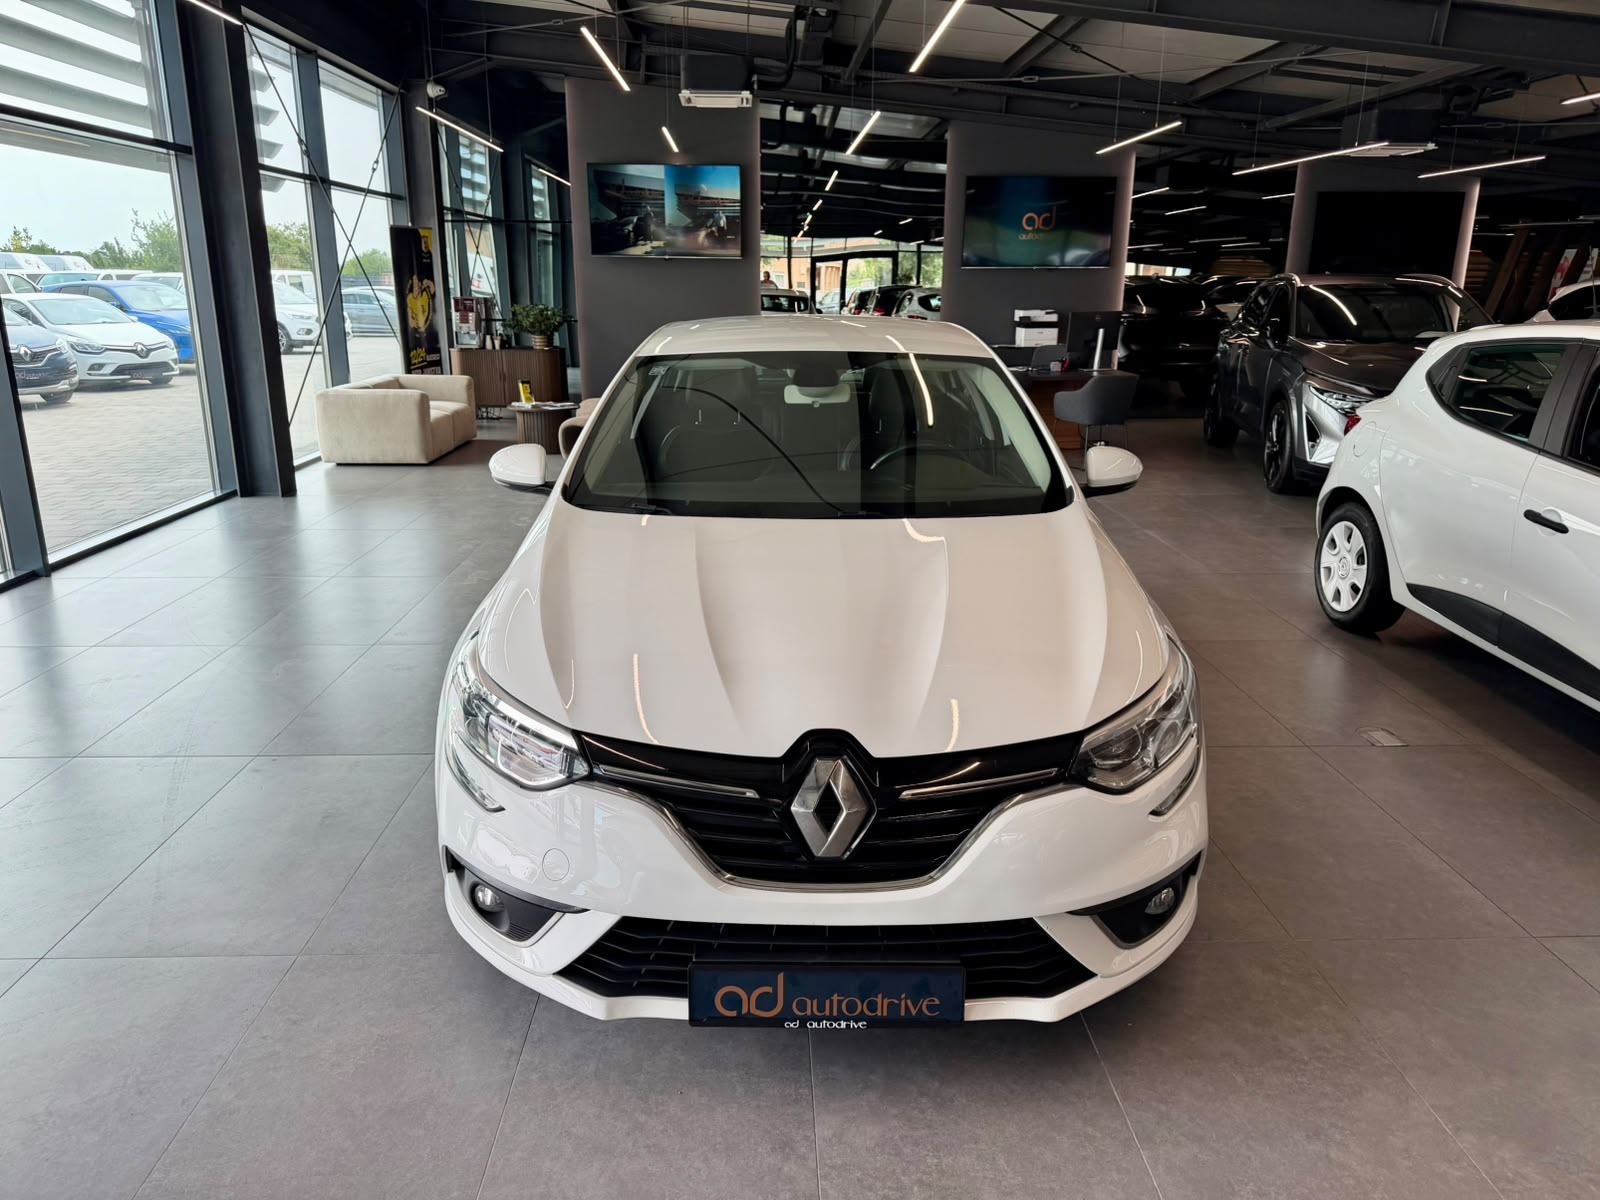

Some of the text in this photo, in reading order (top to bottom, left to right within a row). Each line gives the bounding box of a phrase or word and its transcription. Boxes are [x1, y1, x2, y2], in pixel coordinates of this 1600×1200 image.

[1023, 206, 1056, 230] ad
[714, 972, 941, 1018] ad autodrive
[784, 1019, 868, 1029] ad autodrive
